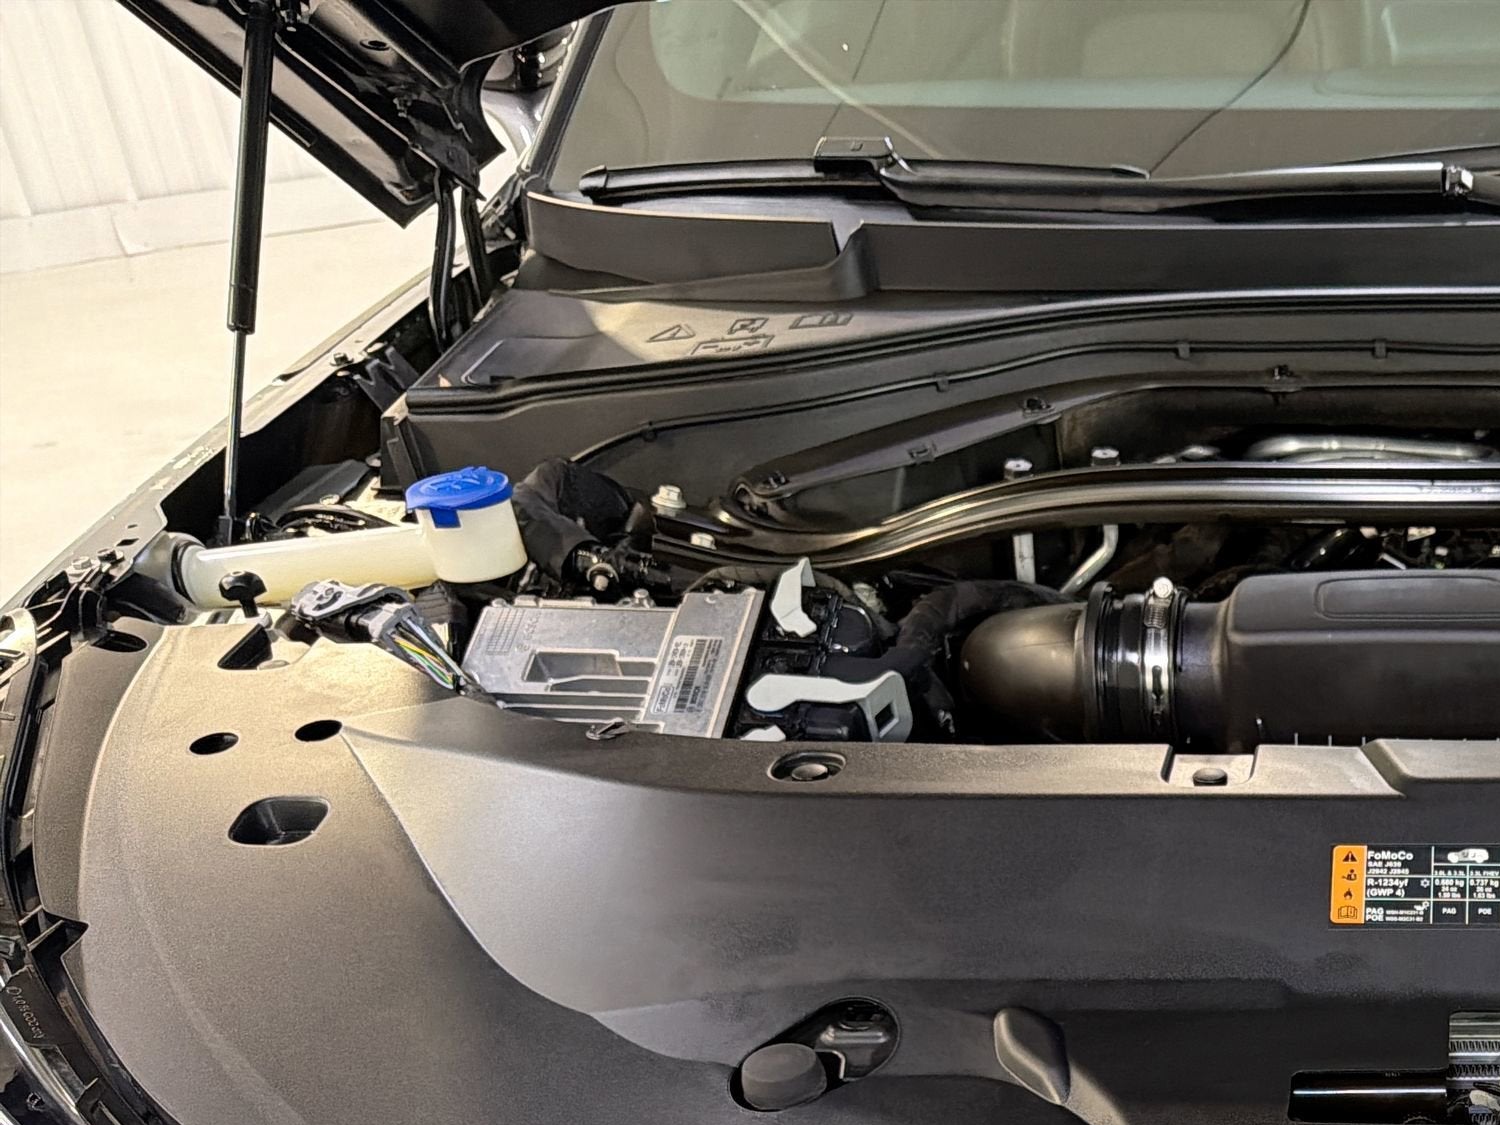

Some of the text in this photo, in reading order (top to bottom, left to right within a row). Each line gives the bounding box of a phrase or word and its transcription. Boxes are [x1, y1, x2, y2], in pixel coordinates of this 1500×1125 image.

[1367, 850, 1414, 860] FoMoCo
[1367, 878, 1409, 888] R-1234yf
[1455, 879, 1465, 887] kg
[1490, 879, 1499, 887] kg
[1366, 888, 1405, 897] (GWP 4)
[1366, 907, 1384, 915] PAG
